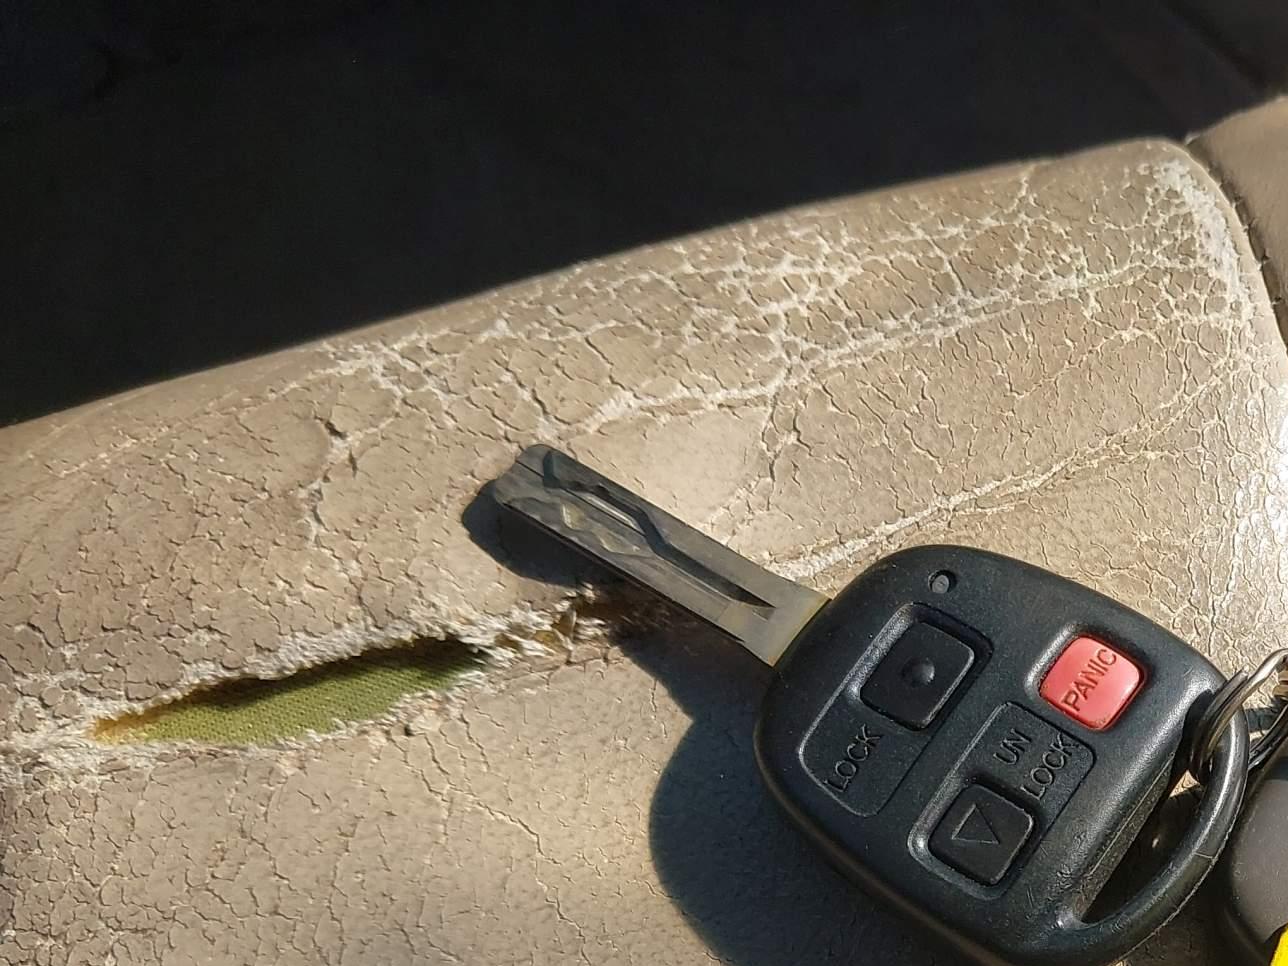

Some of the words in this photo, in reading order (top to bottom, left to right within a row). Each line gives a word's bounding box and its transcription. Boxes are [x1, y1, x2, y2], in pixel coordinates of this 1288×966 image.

[1061, 647, 1118, 712] PANIC
[825, 723, 883, 793] LOCK
[992, 727, 1033, 767] UN
[1020, 730, 1078, 801] LOCK
